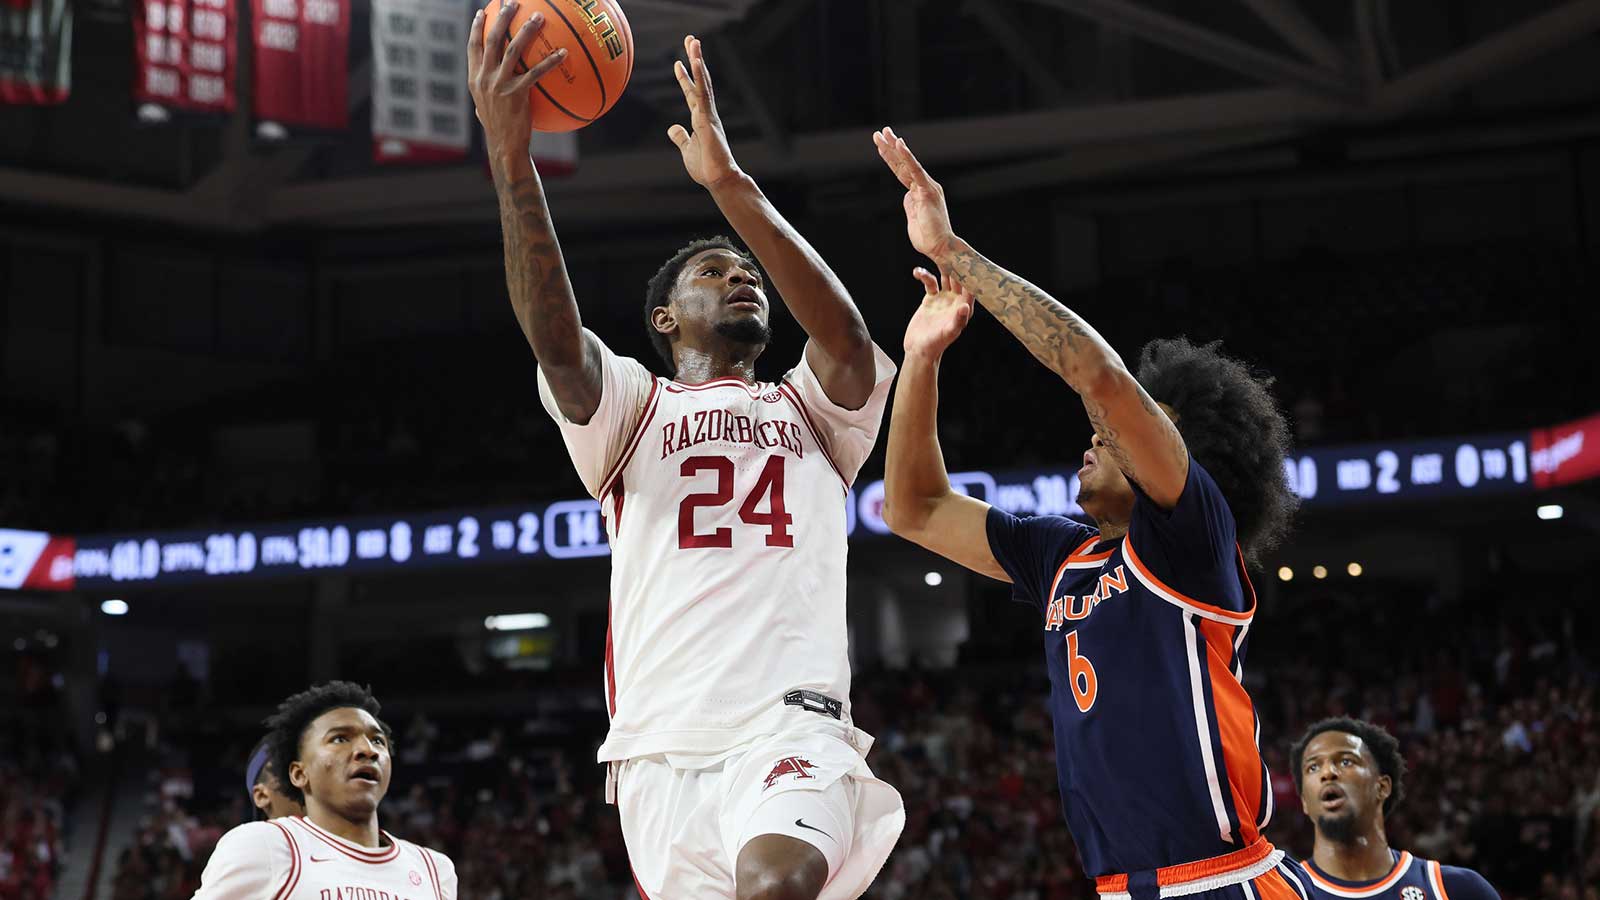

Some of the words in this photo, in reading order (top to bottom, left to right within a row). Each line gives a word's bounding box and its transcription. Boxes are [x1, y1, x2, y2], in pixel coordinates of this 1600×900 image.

[574, 0, 623, 61] LITE
[763, 391, 782, 402] SEC
[1376, 450, 1400, 494] 2
[1455, 443, 1480, 488] 0
[1508, 440, 1527, 484] 1
[678, 455, 794, 549] 24
[205, 532, 257, 575] 20.0
[298, 525, 350, 569] 50.0
[457, 516, 480, 558] 2
[517, 512, 540, 554] 2
[1066, 629, 1098, 713] 6
